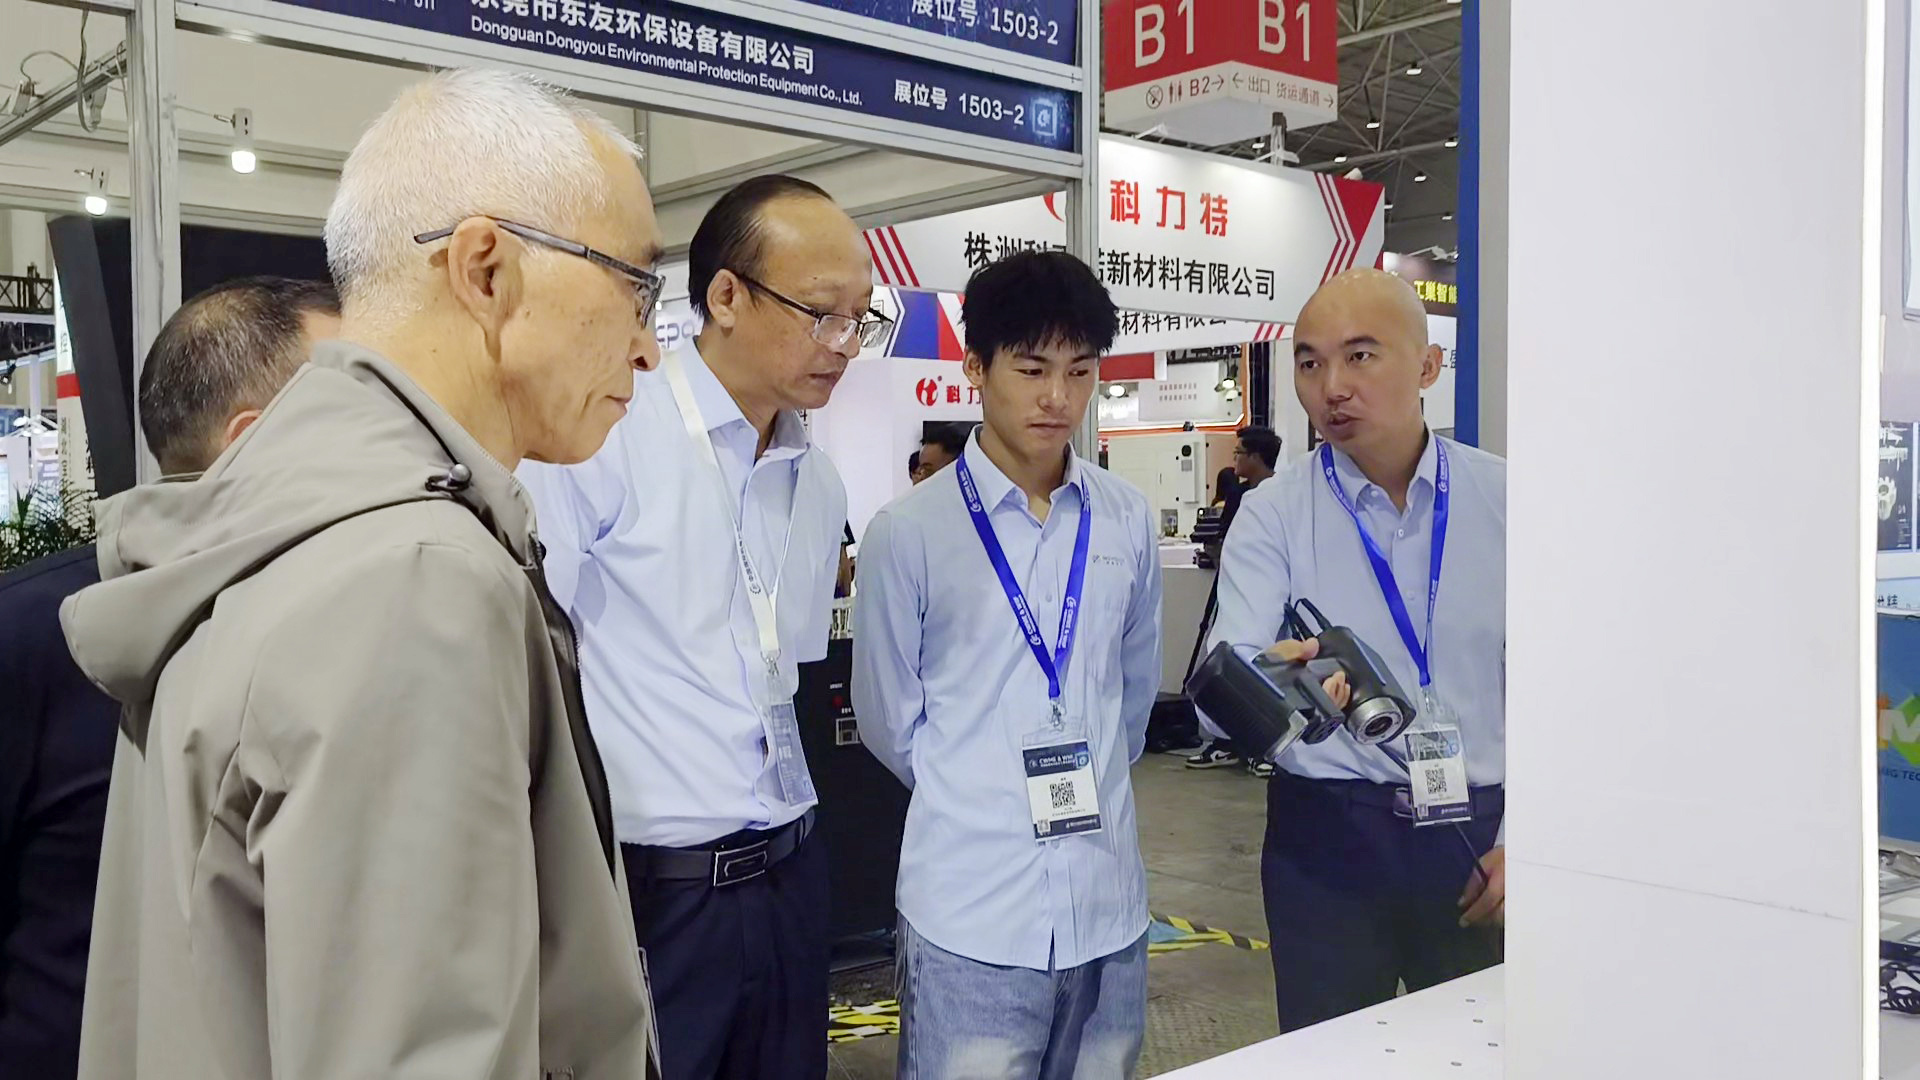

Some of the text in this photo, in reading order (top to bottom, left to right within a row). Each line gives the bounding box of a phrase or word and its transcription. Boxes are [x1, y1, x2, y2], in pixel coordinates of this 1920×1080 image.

[911, 0, 1059, 46] 展位号 1503-2
[1135, 0, 1194, 68] B1
[1258, 0, 1310, 62] B1
[471, 15, 863, 106] Dongguan Dongyou Environmental Protection Equipment Co., Ltd.
[1190, 75, 1210, 97] B2
[894, 78, 1025, 126] 展位号 1503-2
[1248, 75, 1320, 107] 出口 货运通道
[1110, 179, 1228, 237] 科力特
